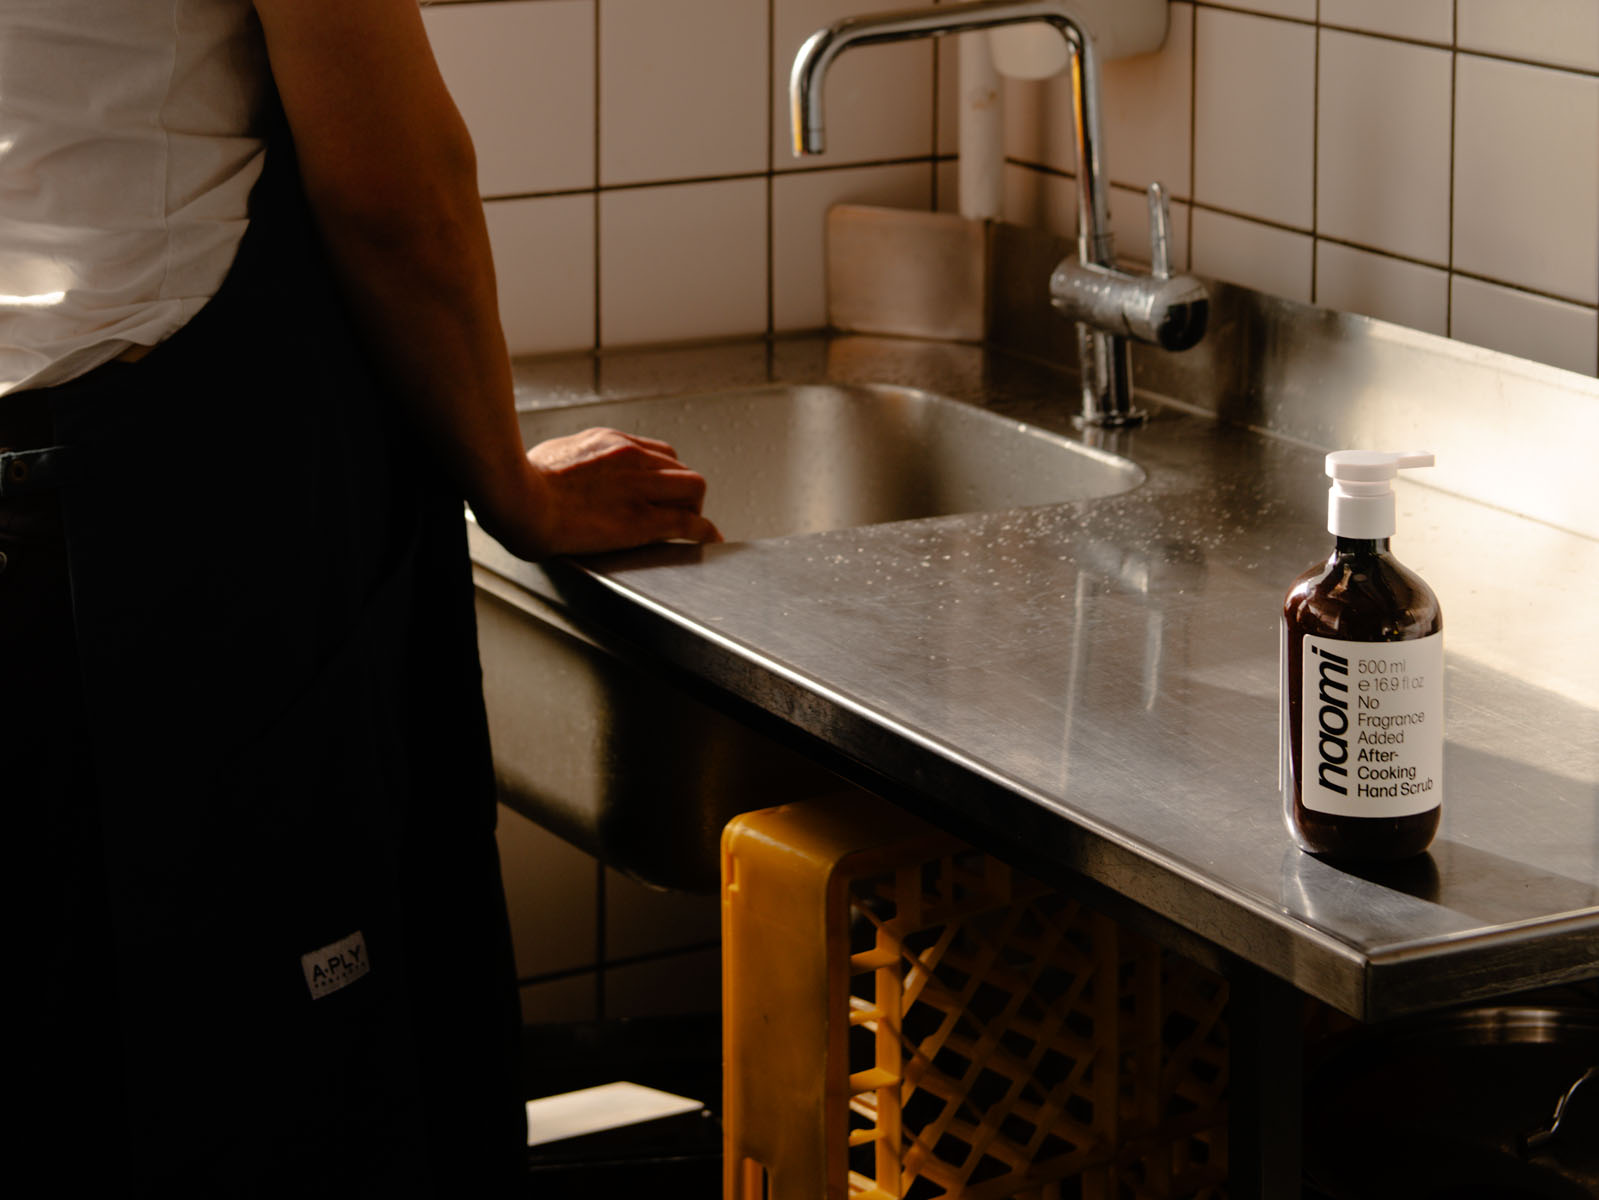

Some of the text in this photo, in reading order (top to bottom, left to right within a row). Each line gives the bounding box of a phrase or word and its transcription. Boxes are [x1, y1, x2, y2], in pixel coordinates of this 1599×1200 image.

[1357, 659, 1406, 674] 500 ml
[1374, 677, 1399, 692] 16.9
[1357, 695, 1380, 710] No
[1311, 645, 1349, 796] naomi
[1357, 711, 1425, 730] Fragrance
[1357, 730, 1404, 745] Added
[1357, 748, 1399, 762] After-
[1357, 765, 1416, 781] Cooking
[1357, 777, 1433, 798] Hand Scrub
